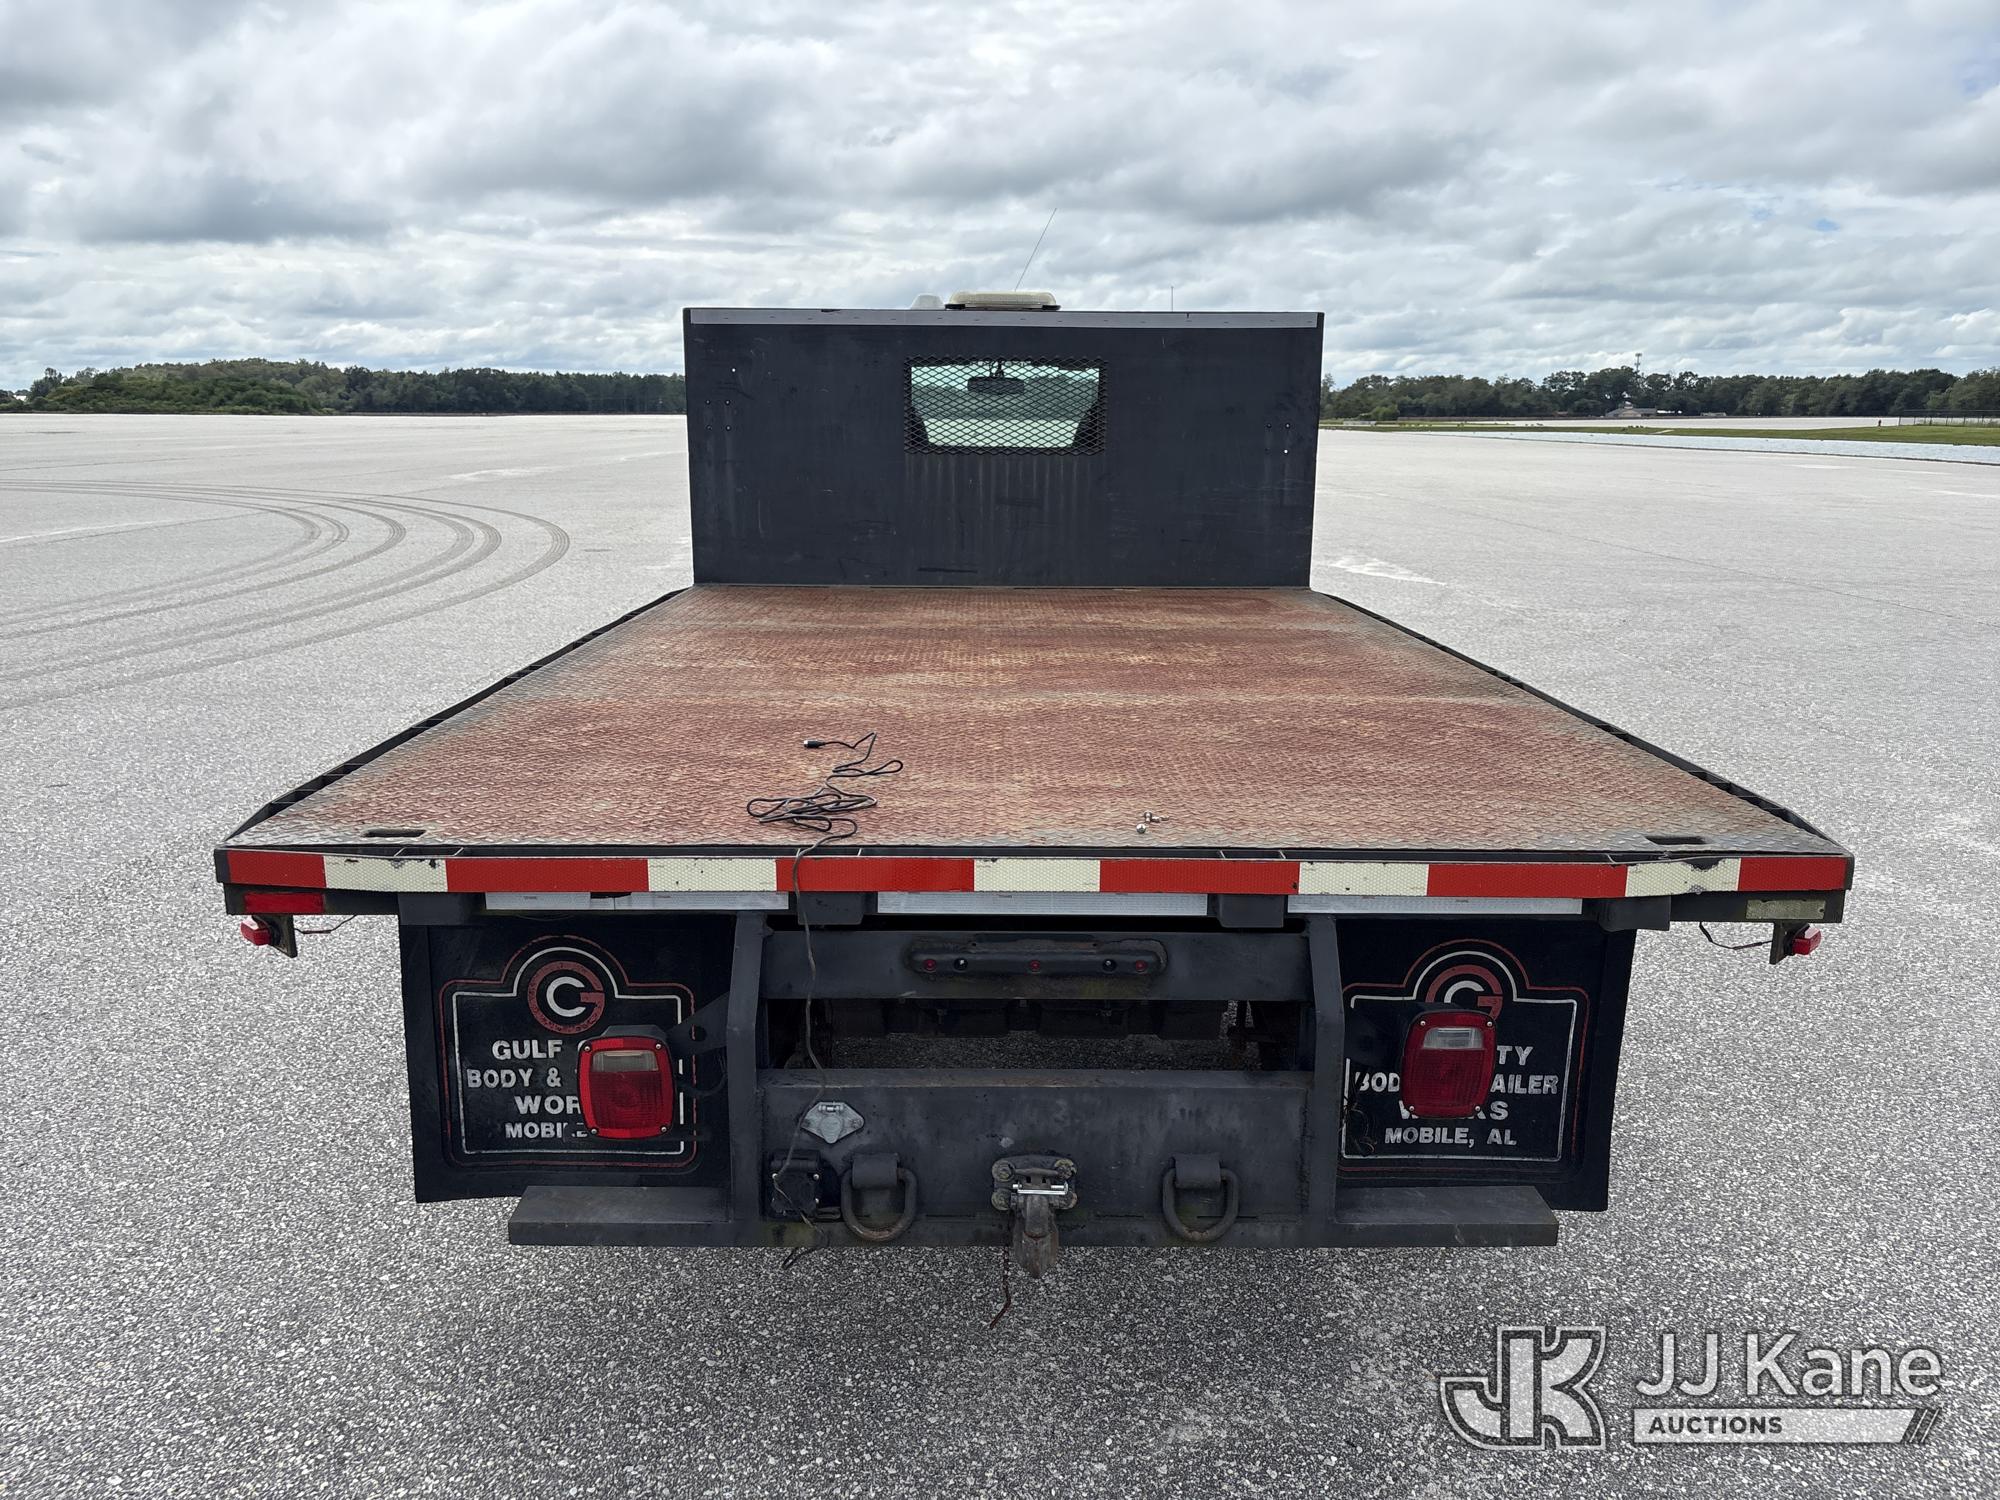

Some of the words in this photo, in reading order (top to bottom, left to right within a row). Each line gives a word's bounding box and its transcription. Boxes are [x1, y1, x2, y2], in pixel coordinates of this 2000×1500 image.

[492, 1039, 563, 1060] GULF
[1496, 1045, 1533, 1066] TY
[466, 1068, 533, 1088] BODY
[546, 1067, 562, 1087] &
[1355, 1071, 1401, 1092] BOD
[1490, 1074, 1558, 1095] AILER
[514, 1095, 582, 1115] WOR
[1384, 1127, 1475, 1147] MOBILE,
[1486, 1129, 1517, 1146] AL
